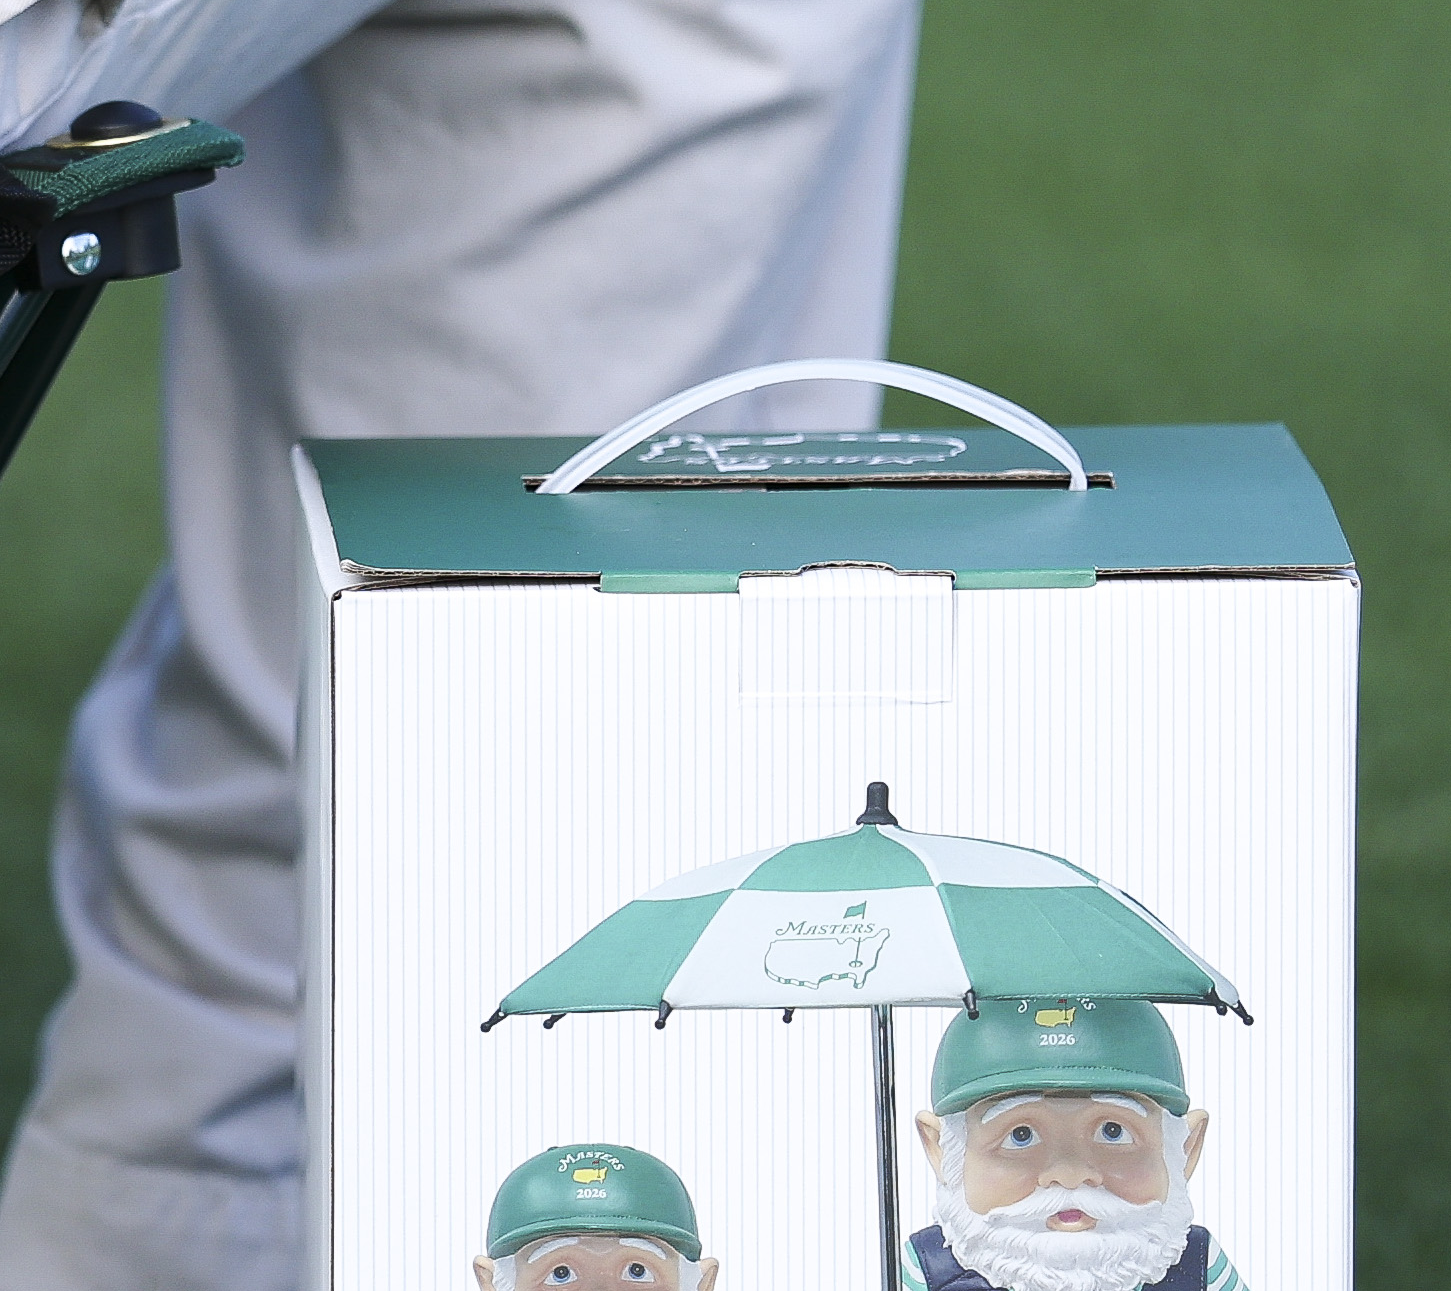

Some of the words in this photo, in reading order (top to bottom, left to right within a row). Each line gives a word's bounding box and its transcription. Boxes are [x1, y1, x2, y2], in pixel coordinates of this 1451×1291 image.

[775, 920, 875, 936] MASTERS
[1039, 1033, 1076, 1046] 2026
[557, 1151, 625, 1173] MASTERS
[576, 1188, 607, 1200] 2026
